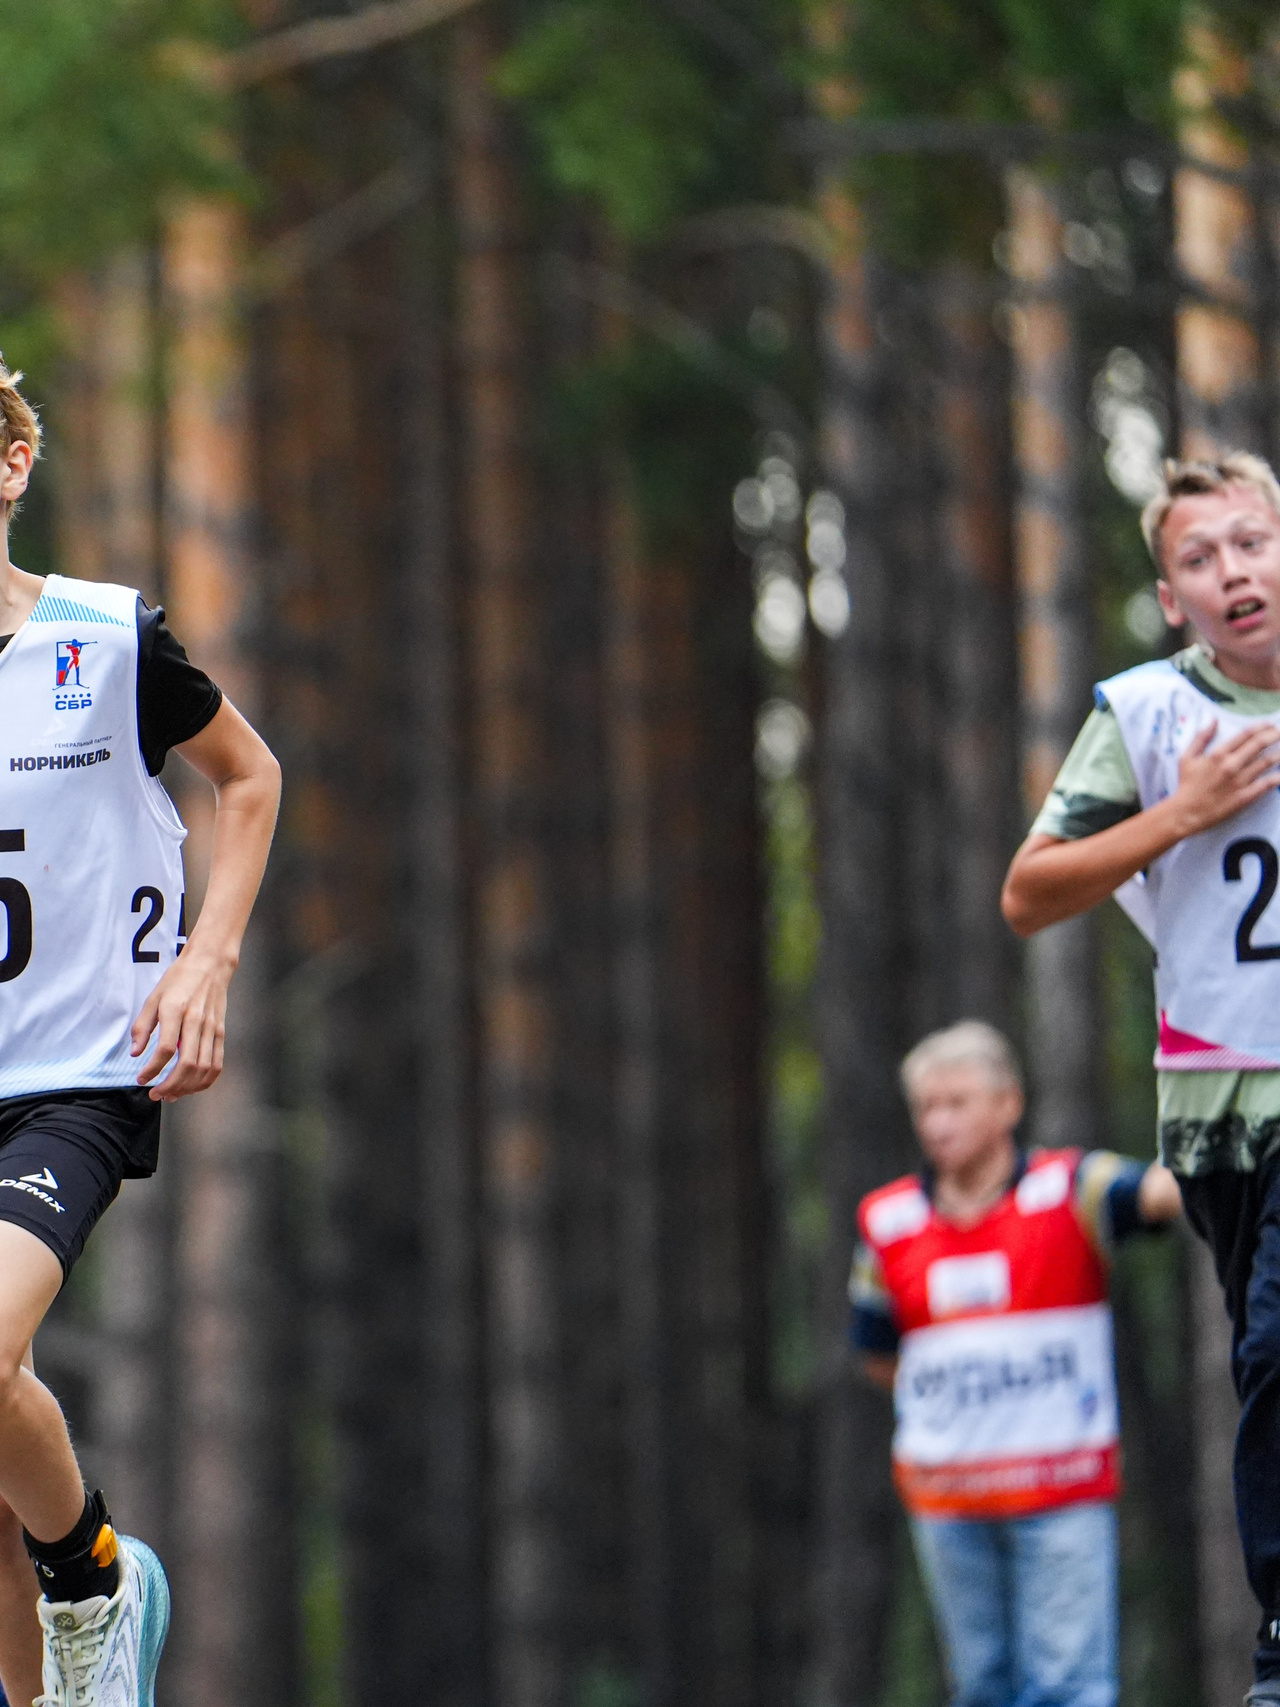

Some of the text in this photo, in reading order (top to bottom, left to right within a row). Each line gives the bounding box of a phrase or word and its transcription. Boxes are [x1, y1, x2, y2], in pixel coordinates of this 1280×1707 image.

[55, 699, 92, 710] СБР
[54, 740, 94, 748] ГЕНЕРАЛЬНЫЙ
[10, 748, 111, 771] НОРНИКЕЛЬ
